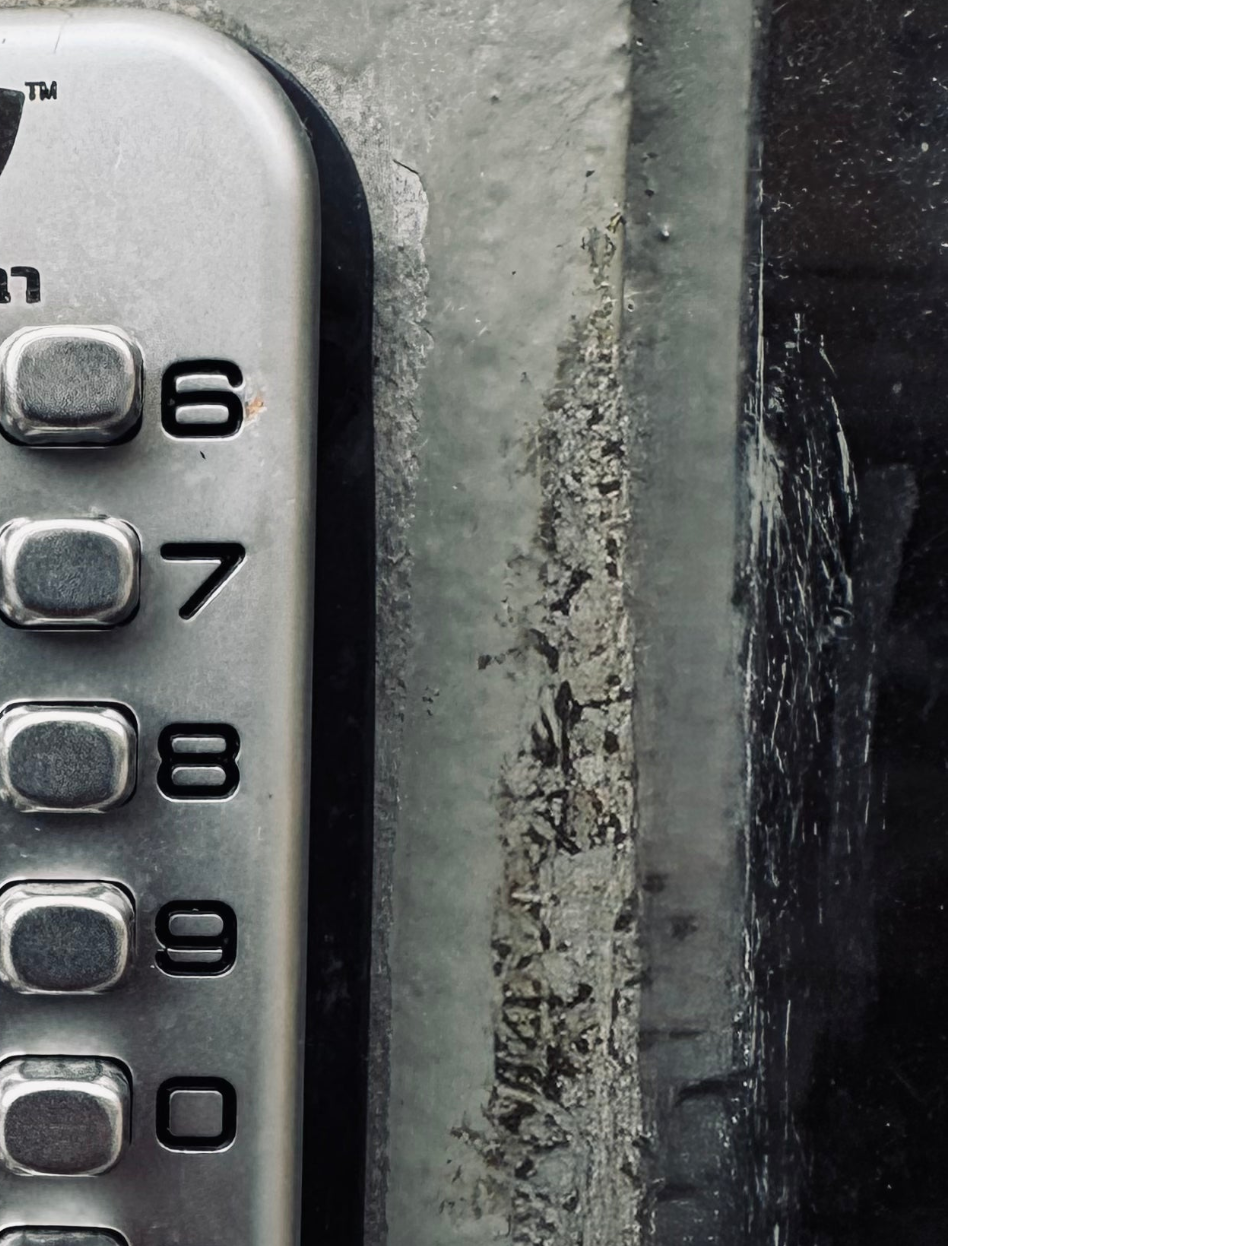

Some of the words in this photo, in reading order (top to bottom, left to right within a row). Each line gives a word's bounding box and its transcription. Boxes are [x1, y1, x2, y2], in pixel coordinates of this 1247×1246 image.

[162, 359, 243, 436] 6
[160, 541, 246, 620] 7
[156, 722, 240, 799] 8
[156, 898, 237, 974] 9
